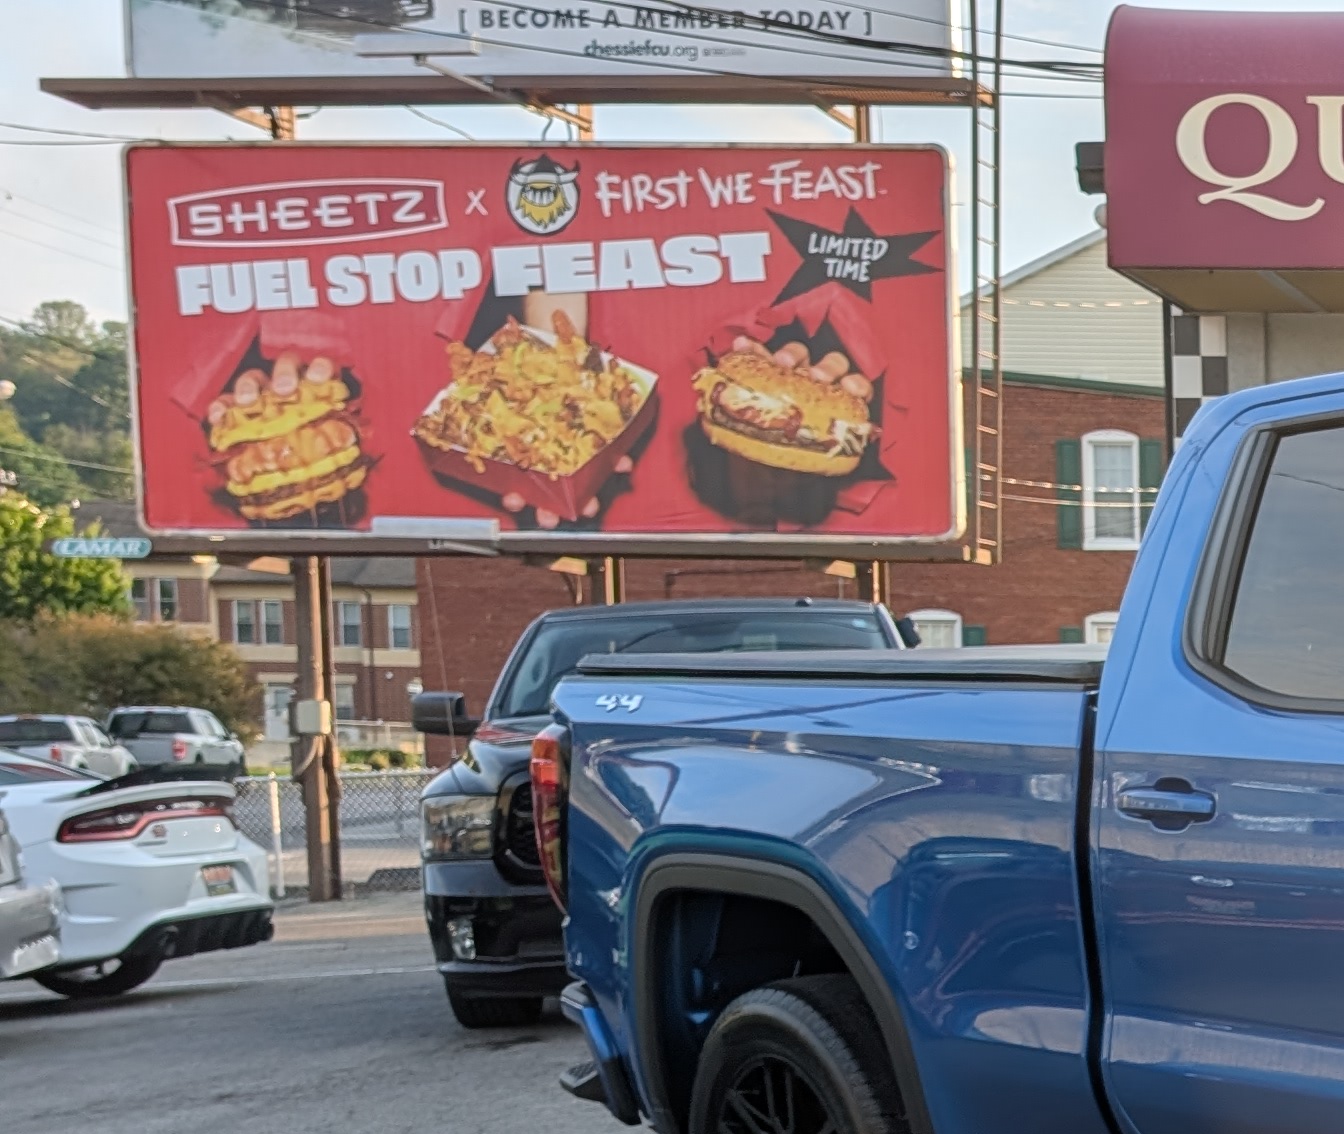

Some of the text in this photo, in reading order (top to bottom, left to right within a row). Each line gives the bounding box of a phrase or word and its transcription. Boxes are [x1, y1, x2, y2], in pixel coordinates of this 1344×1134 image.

[480, 9, 590, 29] BECOME
[603, 9, 621, 28] A
[634, 7, 745, 29] MEMBER
[759, 11, 850, 31] TODAY
[188, 190, 427, 236] SHEETZ
[595, 170, 693, 218] FIRST
[699, 168, 757, 208] WE
[758, 160, 883, 204] FEAST
[808, 233, 889, 263] LIMITED
[174, 232, 771, 316] FUEL STOP FEAST
[824, 257, 873, 283] TIME
